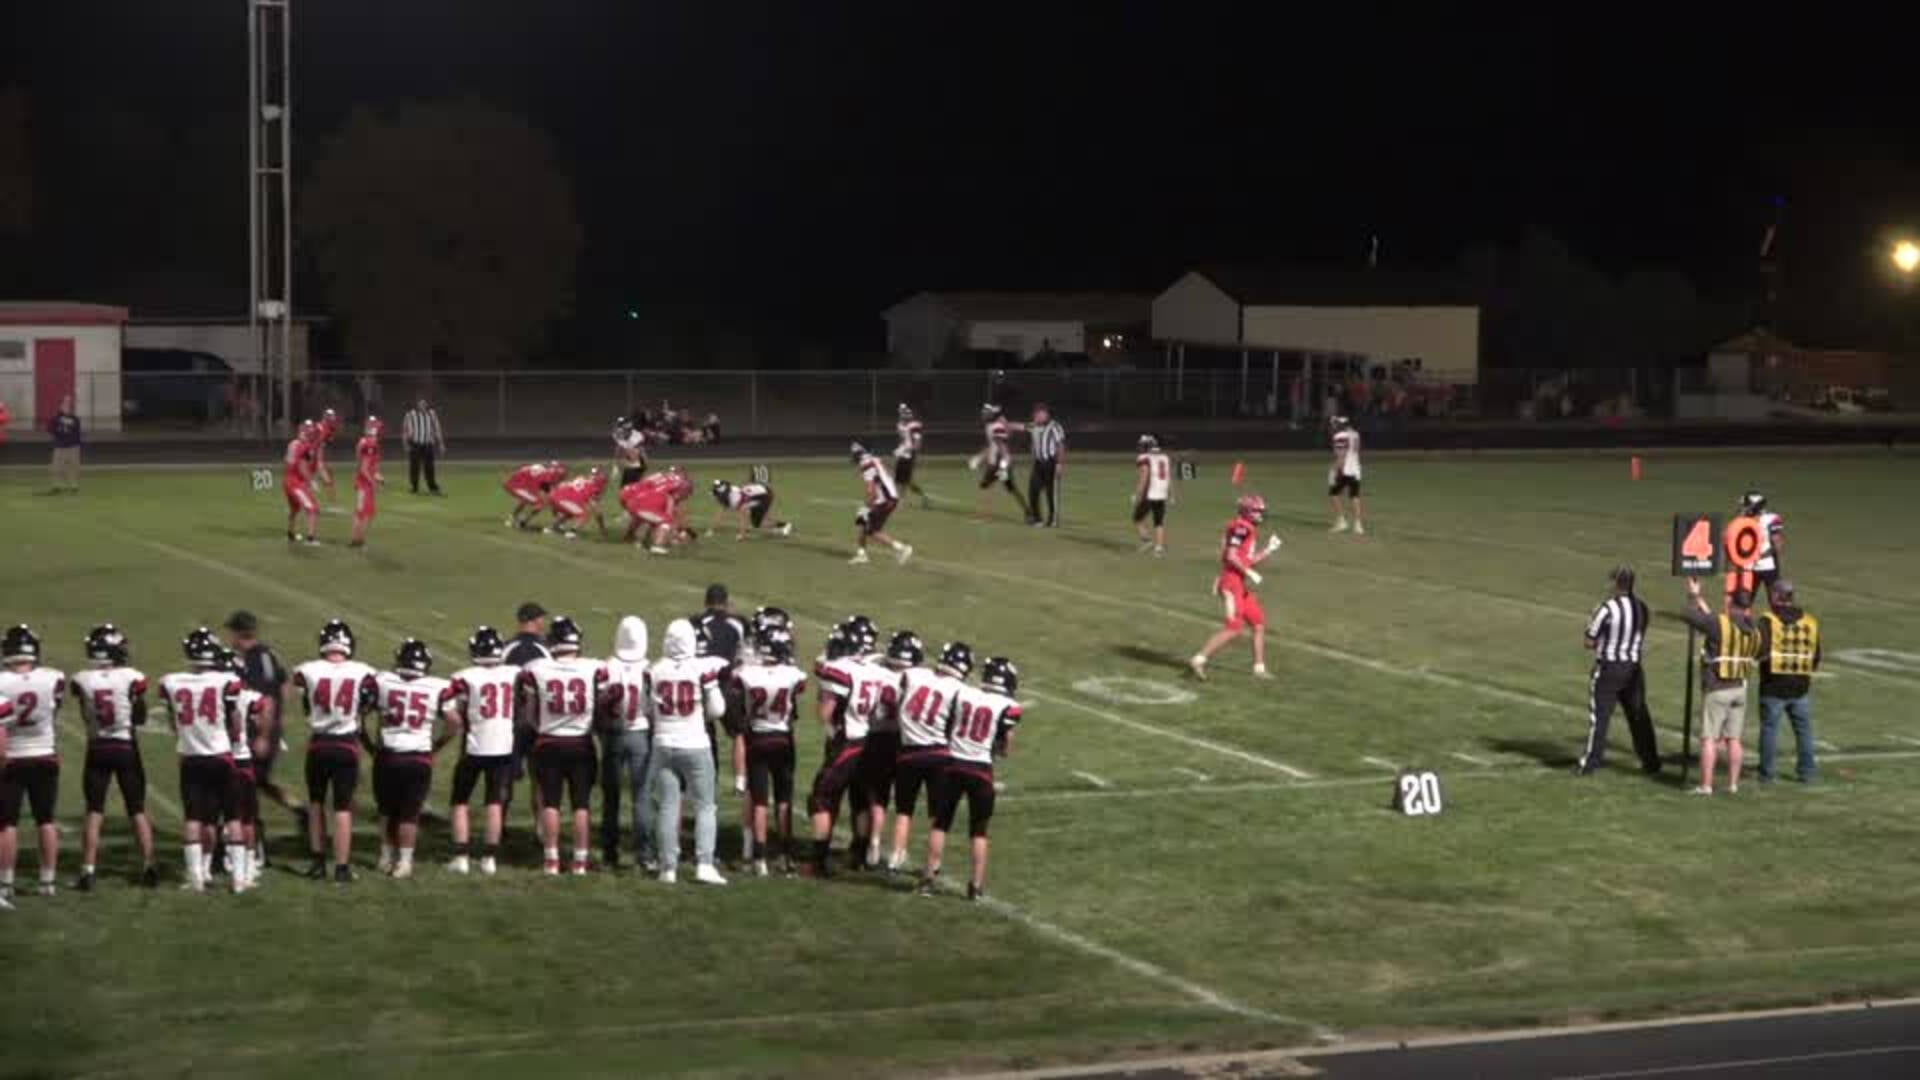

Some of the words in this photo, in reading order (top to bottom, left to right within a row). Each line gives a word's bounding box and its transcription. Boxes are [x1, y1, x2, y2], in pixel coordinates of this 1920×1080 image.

[253, 469, 272, 489] 20
[1682, 518, 1713, 560] 4
[16, 692, 38, 727] 2
[94, 689, 115, 726] 5
[175, 687, 217, 726] 34
[313, 677, 355, 715] 44
[384, 689, 429, 729] 55
[479, 682, 512, 719] 31
[546, 678, 586, 715] 33
[657, 680, 694, 717] 30
[751, 687, 788, 717] 24
[906, 686, 943, 726] 41
[956, 701, 993, 743] 10
[1401, 772, 1441, 815] 20
